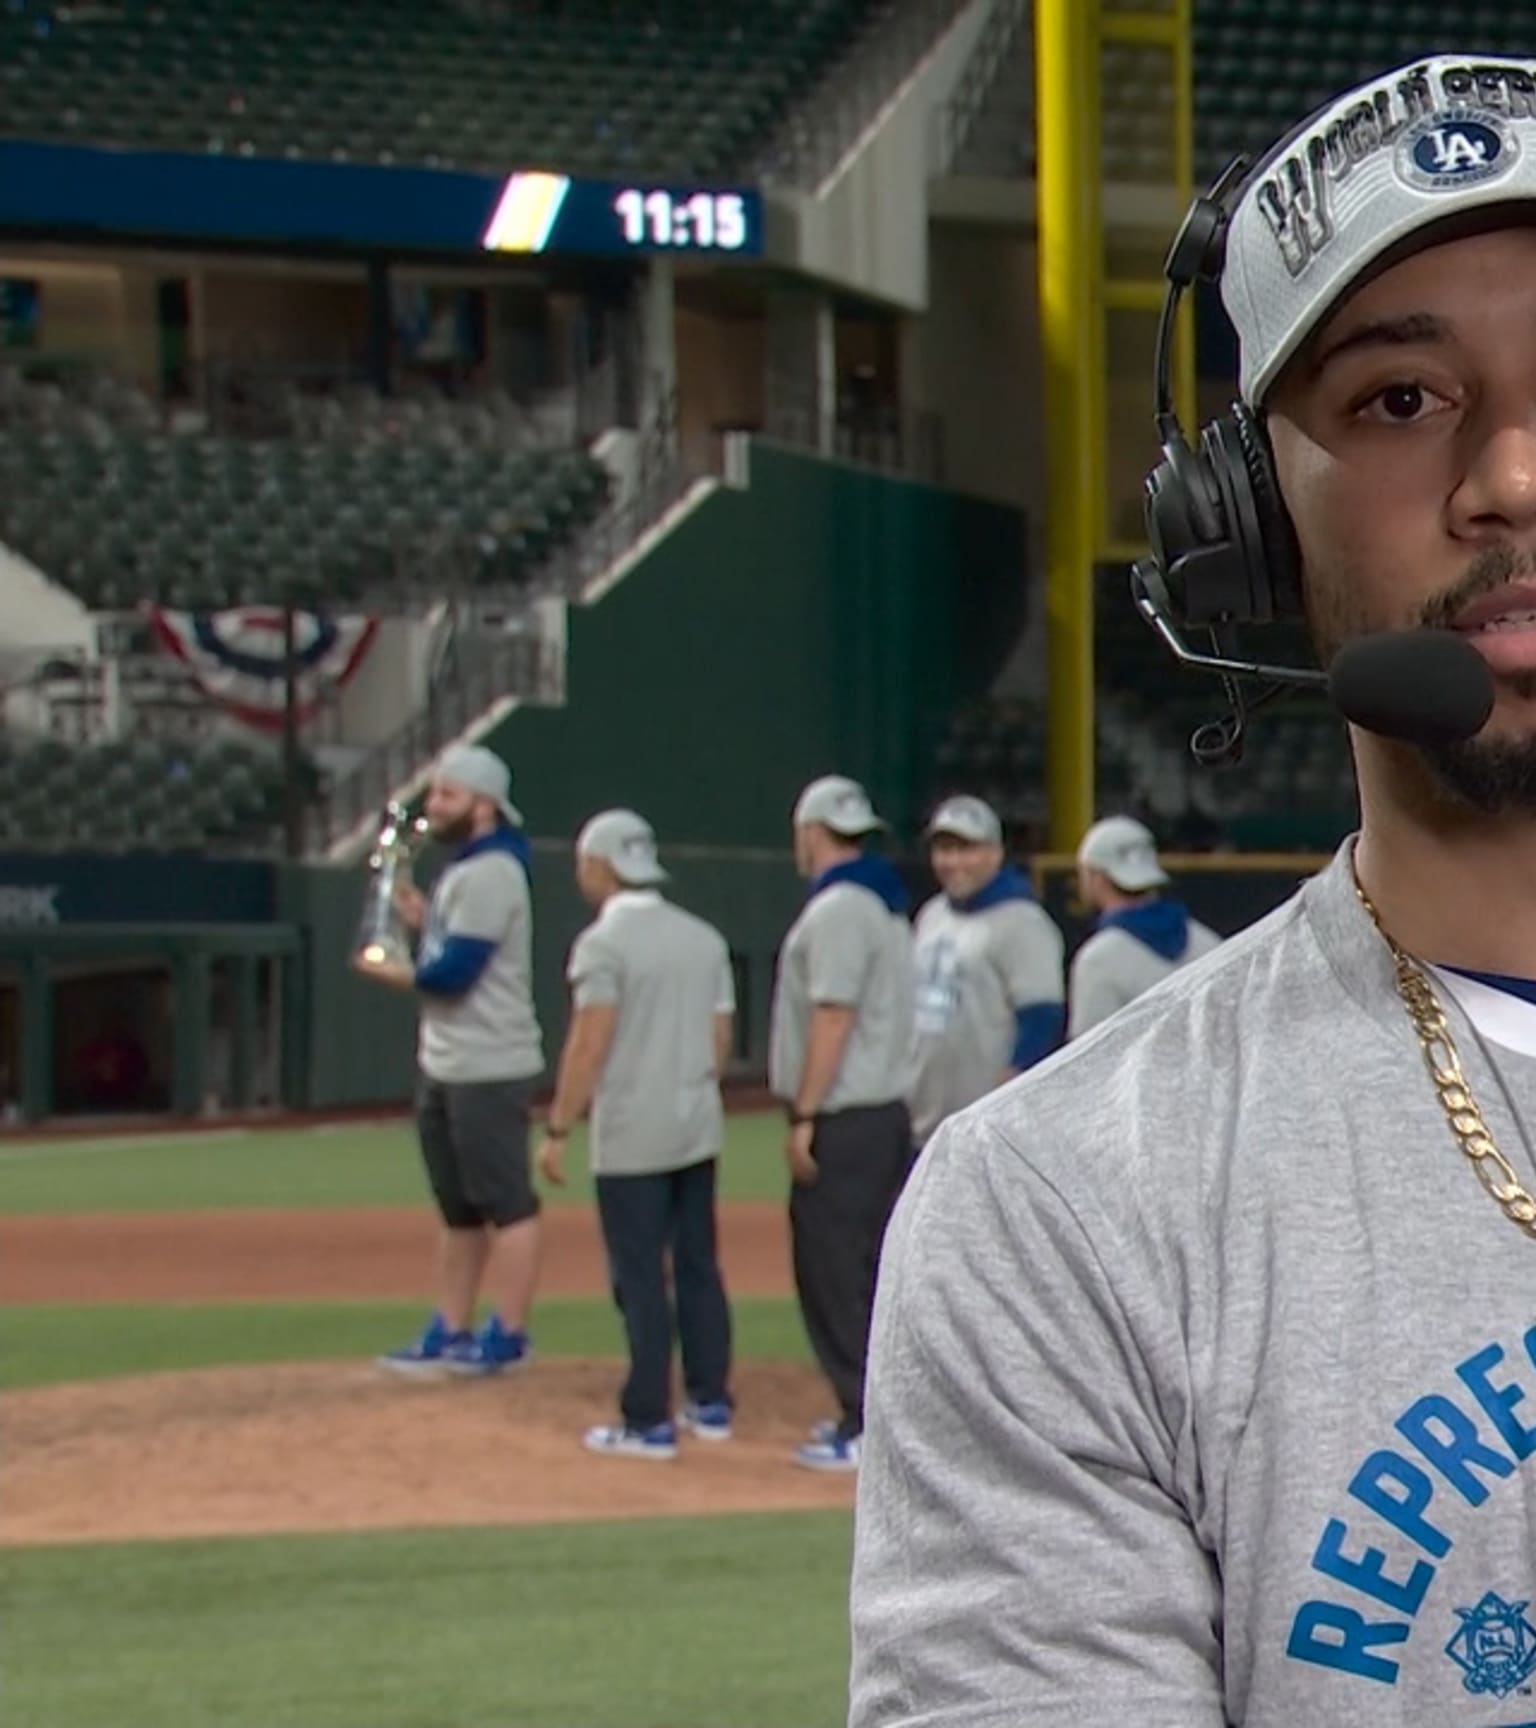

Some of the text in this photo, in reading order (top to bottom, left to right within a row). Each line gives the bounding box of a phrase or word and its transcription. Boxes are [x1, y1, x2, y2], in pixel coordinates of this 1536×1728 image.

[1256, 65, 1436, 279] WORLD
[1428, 128, 1488, 172] LA
[613, 188, 746, 250] 11:15
